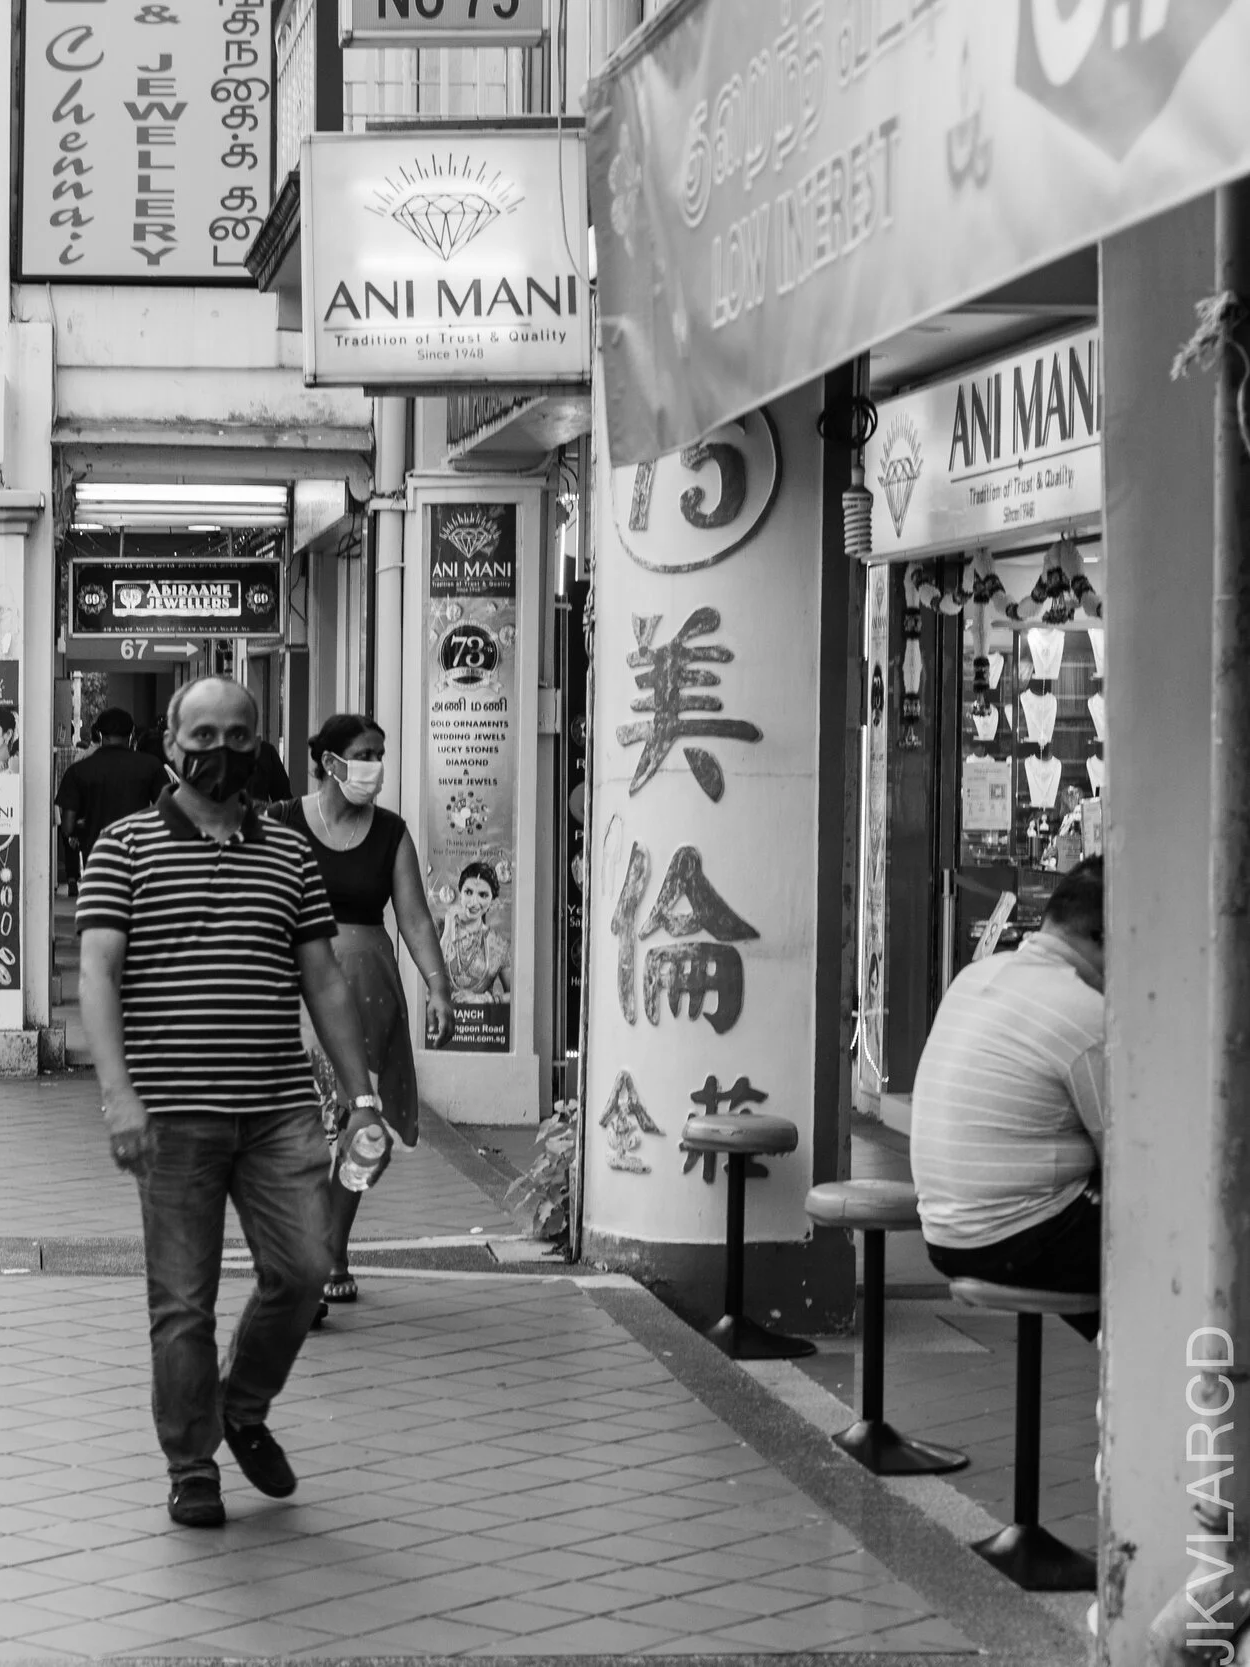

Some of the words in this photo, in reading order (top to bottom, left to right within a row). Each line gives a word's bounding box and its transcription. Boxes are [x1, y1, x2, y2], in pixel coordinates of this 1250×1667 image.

[134, 5, 181, 24] &
[46, 25, 104, 265] Chennai
[124, 53, 187, 266] JEWELLERY
[711, 203, 770, 329] LOW
[777, 117, 899, 298] INTEREST
[323, 280, 414, 321] ANI
[437, 275, 577, 317] MANI
[335, 333, 407, 347] Tradition
[417, 332, 431, 345] of
[441, 333, 481, 345] Trust
[490, 332, 500, 343] &
[509, 330, 567, 345] Quality
[417, 349, 450, 361] Since
[454, 348, 484, 359] 1948
[948, 373, 1001, 472] ANI
[1013, 338, 1100, 454] MANI
[1014, 476, 1033, 494] Trust
[1044, 465, 1074, 489] Quality
[432, 561, 458, 577] ANI
[464, 561, 511, 577] MANI
[146, 582, 232, 597] ABIRAAME
[85, 594, 100, 605] 69
[146, 598, 230, 609] JEWELLERS
[253, 593, 268, 604] 69
[120, 639, 149, 660] 67
[450, 635, 485, 667] 73
[431, 720, 451, 728] GOLD
[454, 720, 509, 728] ORNAMENTS
[433, 733, 470, 741] WEDDING
[474, 733, 506, 741] JEWELS
[437, 746, 462, 754] LUCKY
[465, 746, 499, 754] STONES
[438, 778, 462, 786] SILVER
[466, 778, 498, 786] JEWELS
[482, 1024, 504, 1033] Road
